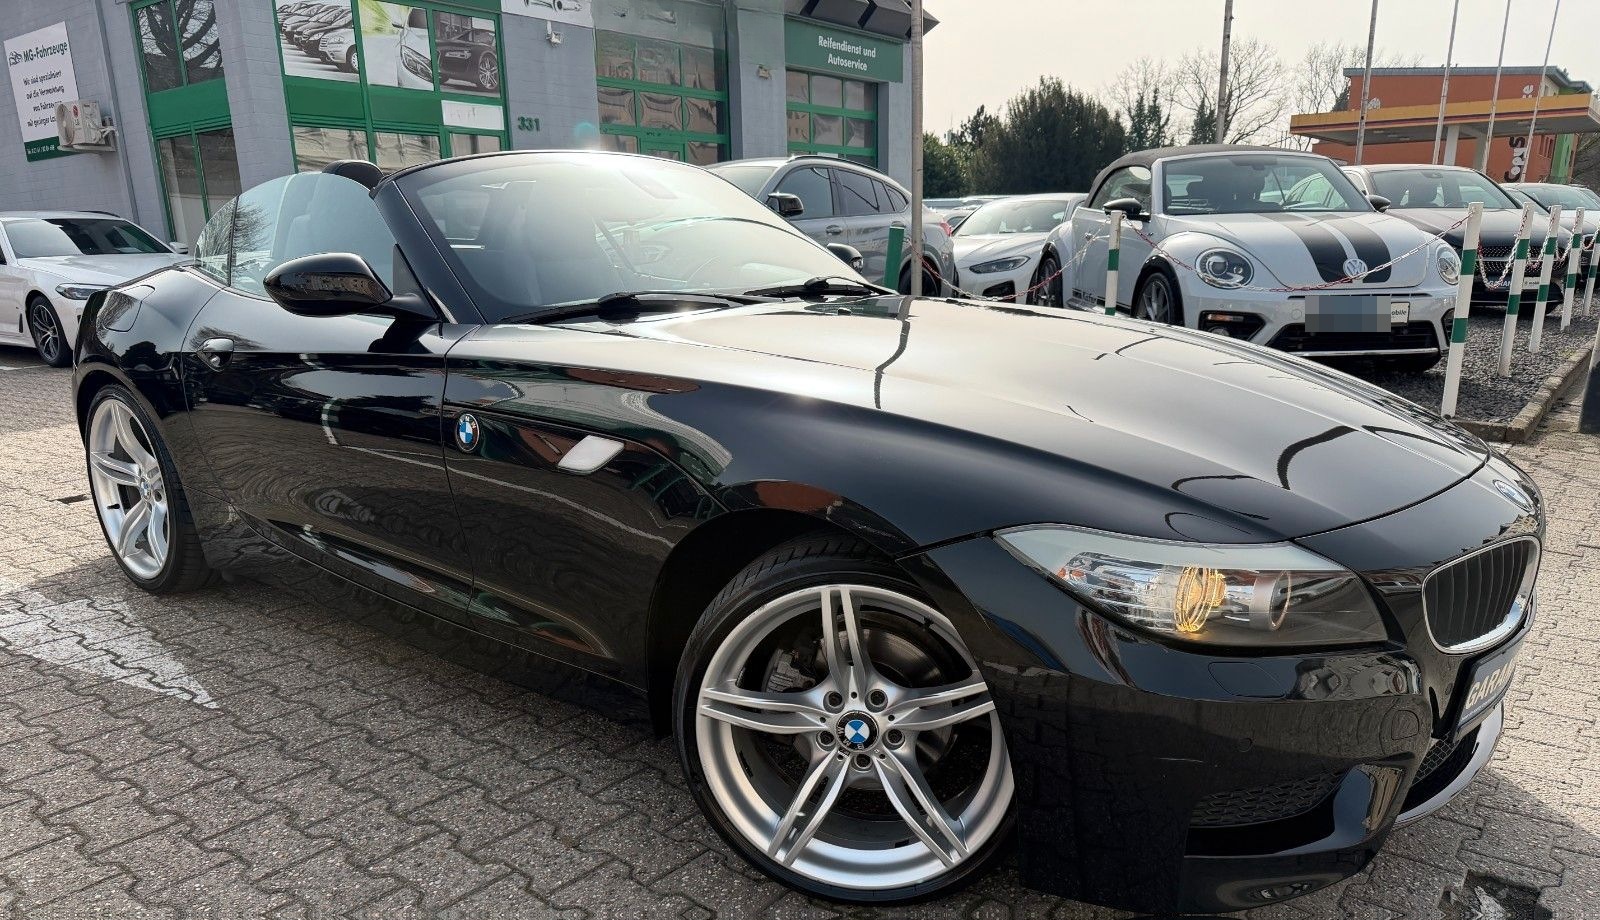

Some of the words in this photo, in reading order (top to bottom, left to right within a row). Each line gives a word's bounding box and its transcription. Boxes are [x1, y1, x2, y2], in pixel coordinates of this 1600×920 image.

[23, 42, 68, 62] MG-Fahrzeuge
[818, 35, 862, 55] Reifendienst
[863, 47, 876, 58] und
[827, 53, 868, 71] Autoservice
[518, 116, 540, 131] 331
